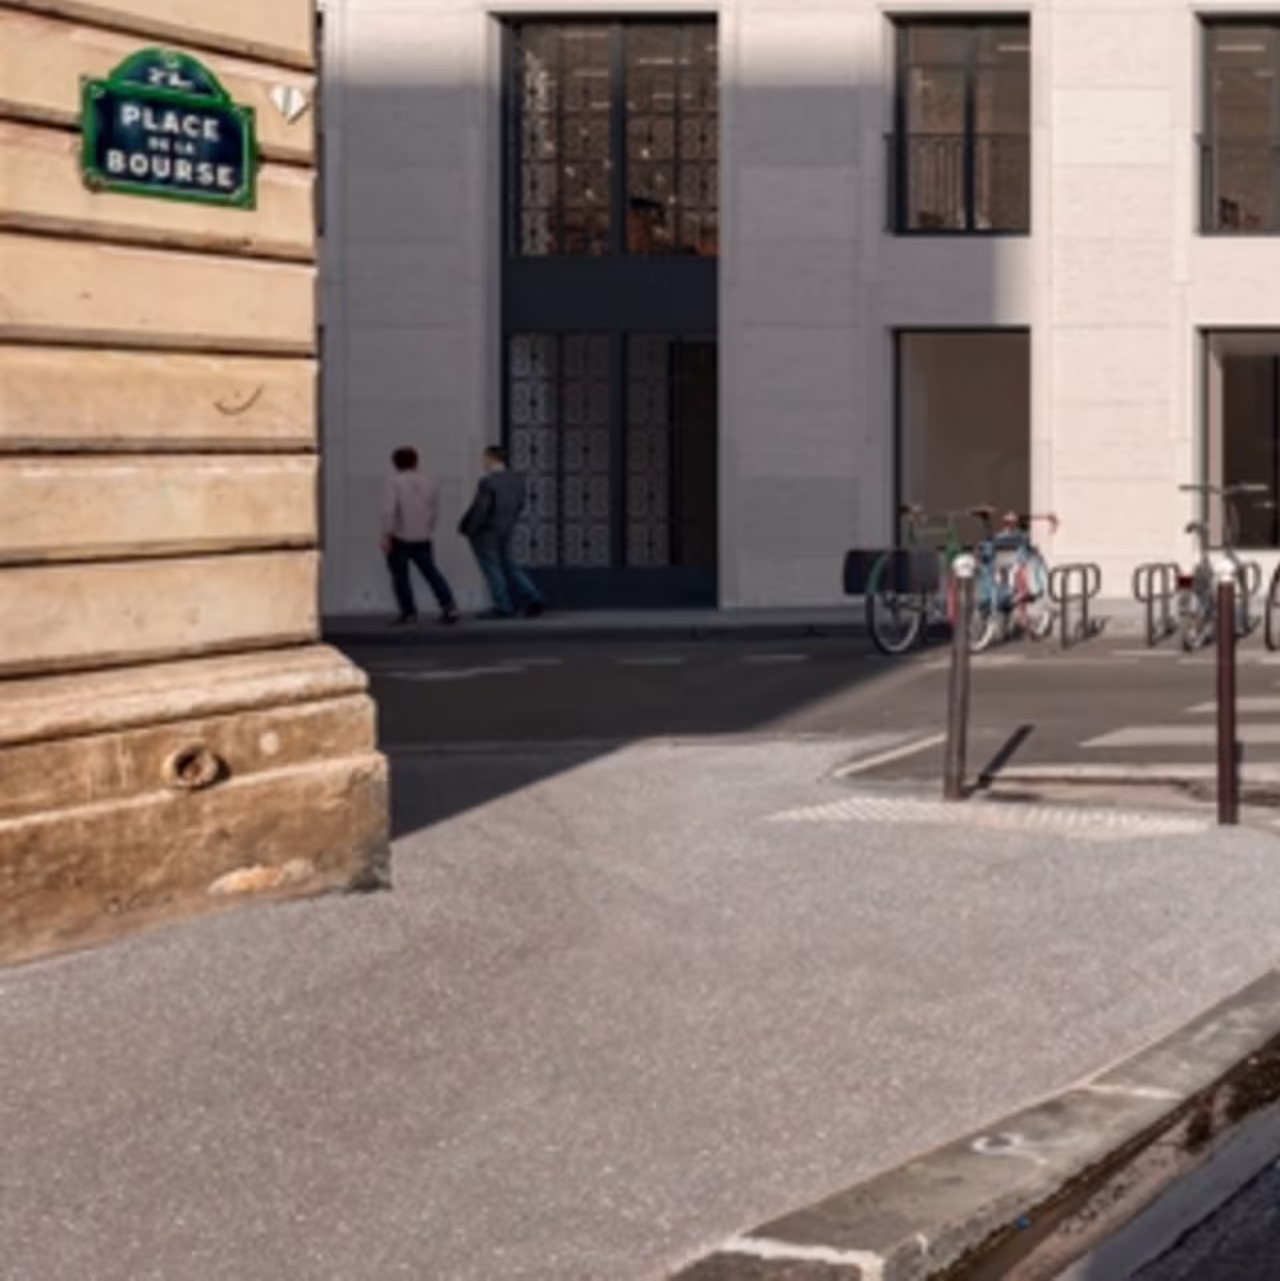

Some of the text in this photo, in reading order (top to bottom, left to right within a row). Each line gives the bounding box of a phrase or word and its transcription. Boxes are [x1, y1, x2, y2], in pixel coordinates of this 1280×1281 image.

[121, 104, 220, 141] PLACE
[148, 137, 195, 155] DE LA
[106, 149, 235, 187] BOURSE
